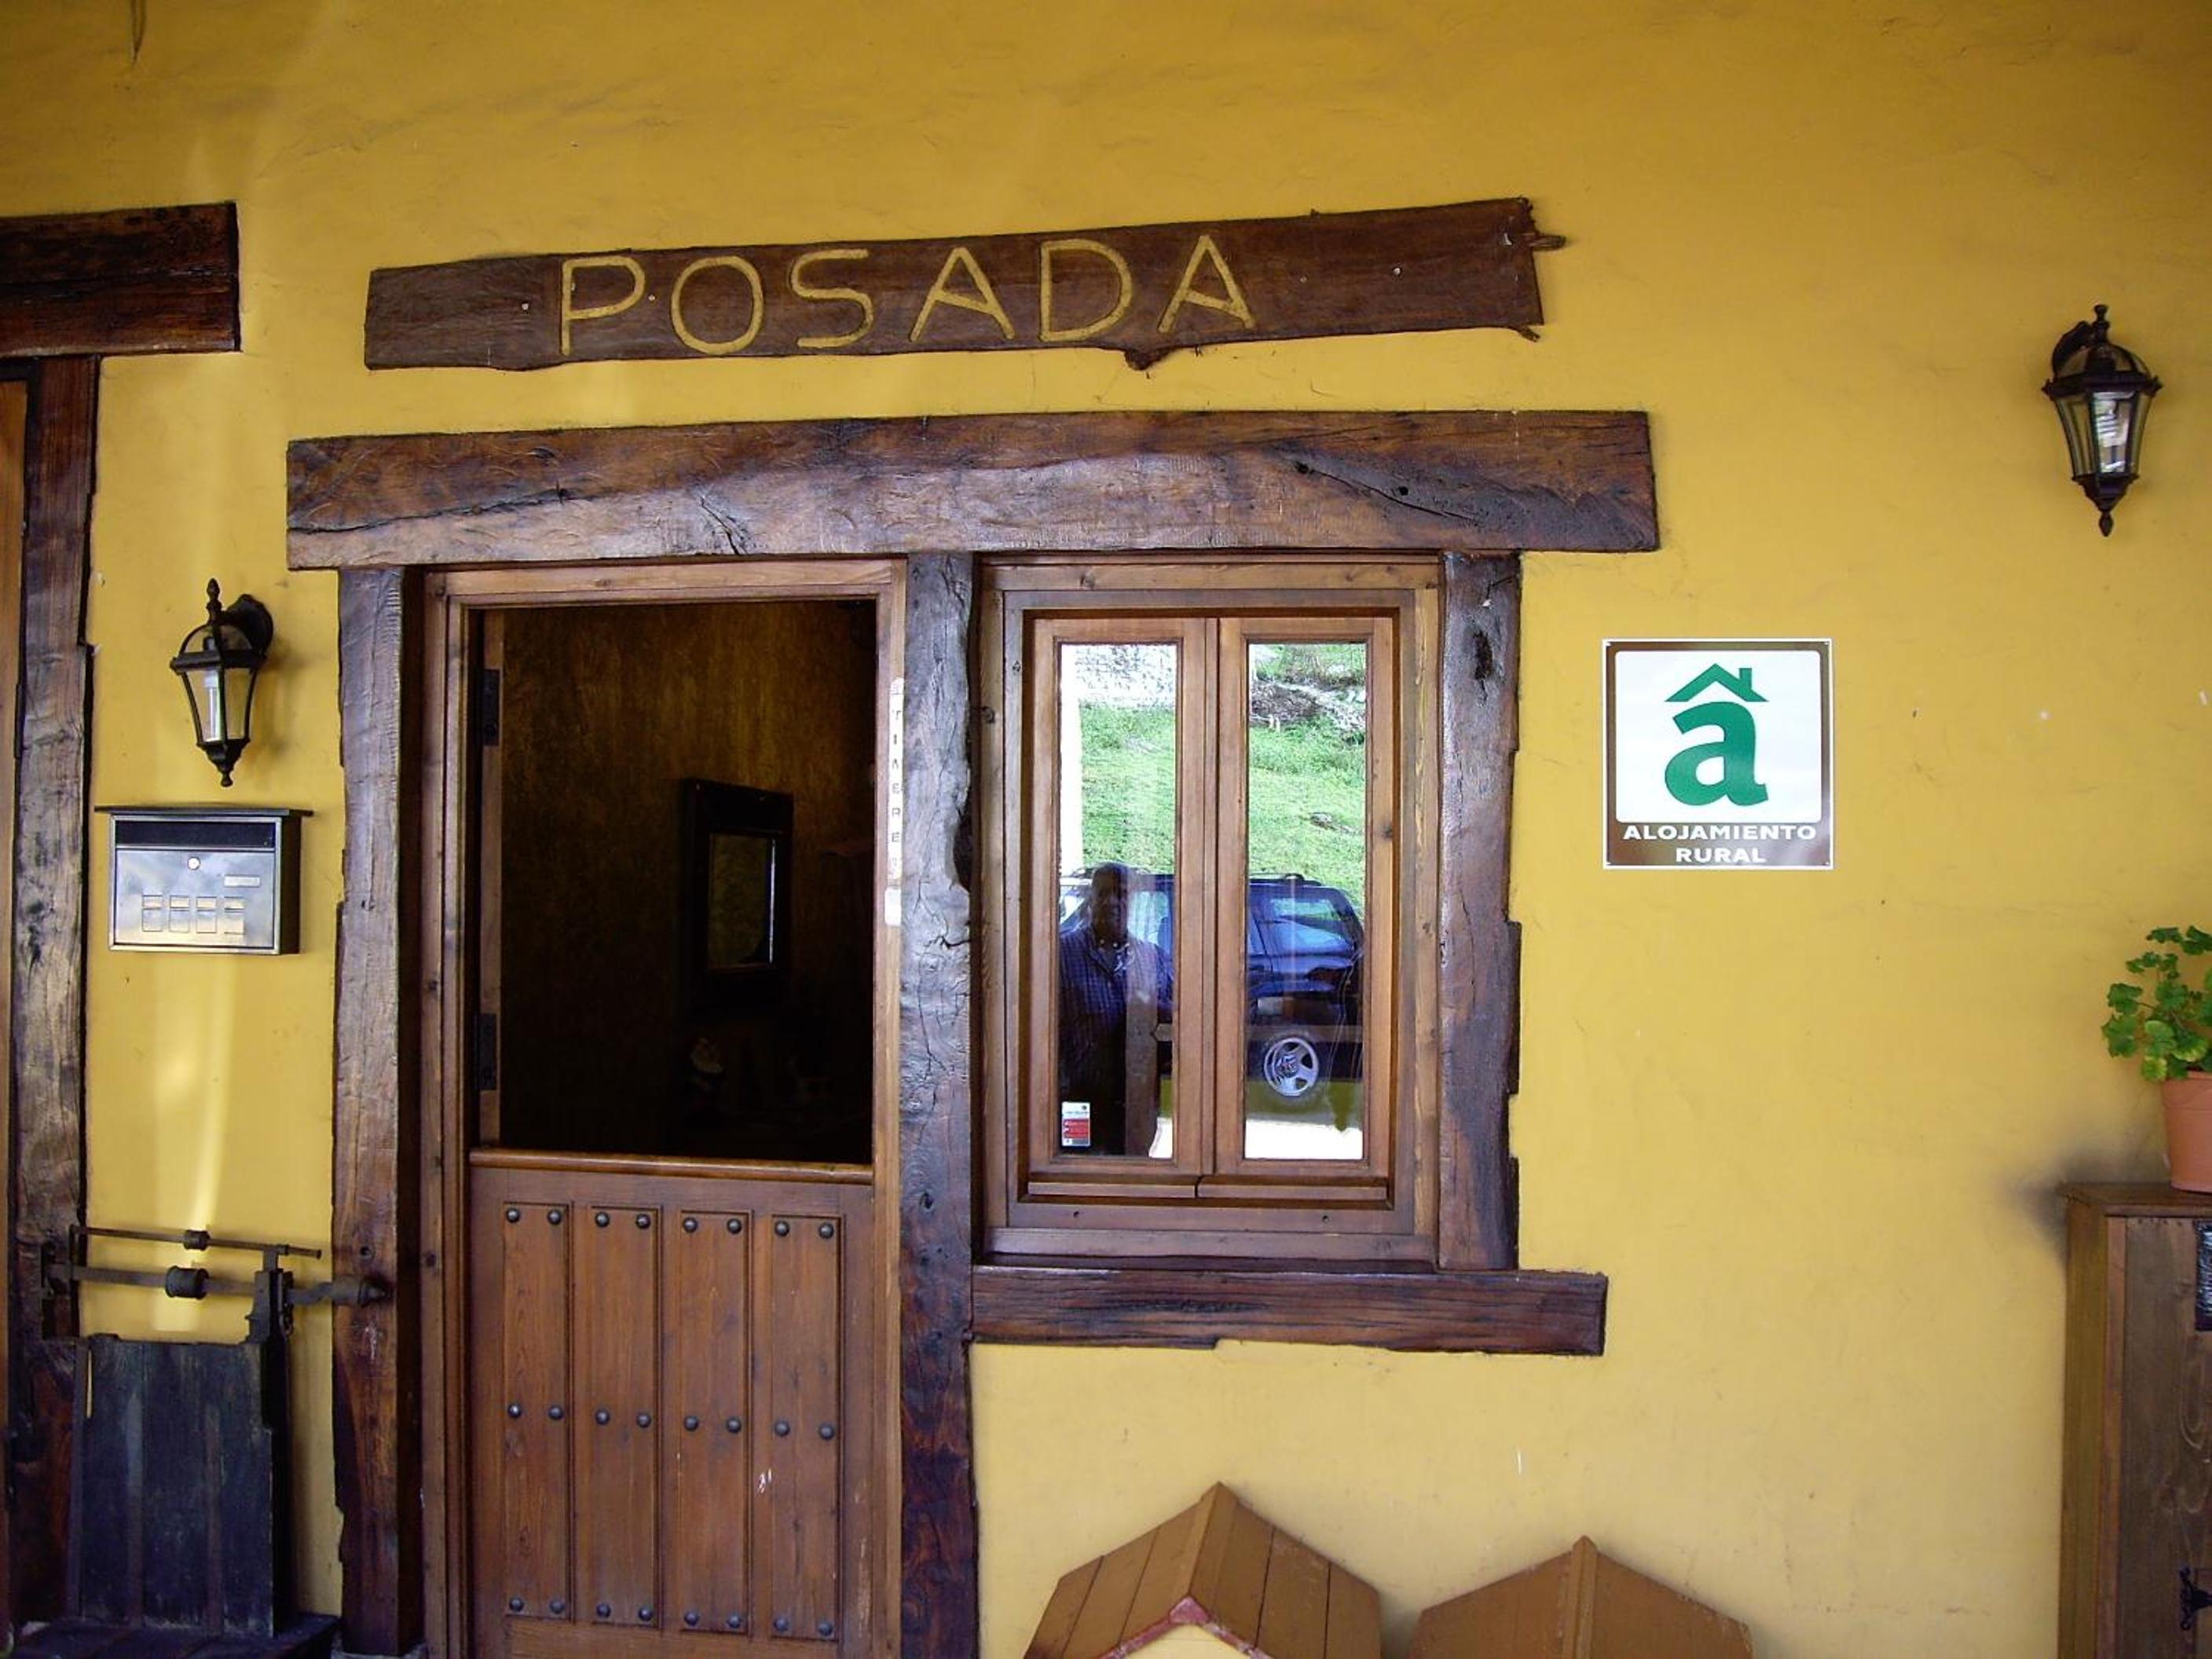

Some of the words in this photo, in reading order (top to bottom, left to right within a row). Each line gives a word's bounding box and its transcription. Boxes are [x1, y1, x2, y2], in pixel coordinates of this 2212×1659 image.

[560, 234, 1254, 356] POSADA
[1623, 825, 1816, 840] ALOJAMIENTO
[1675, 848, 1767, 863] RURAL
